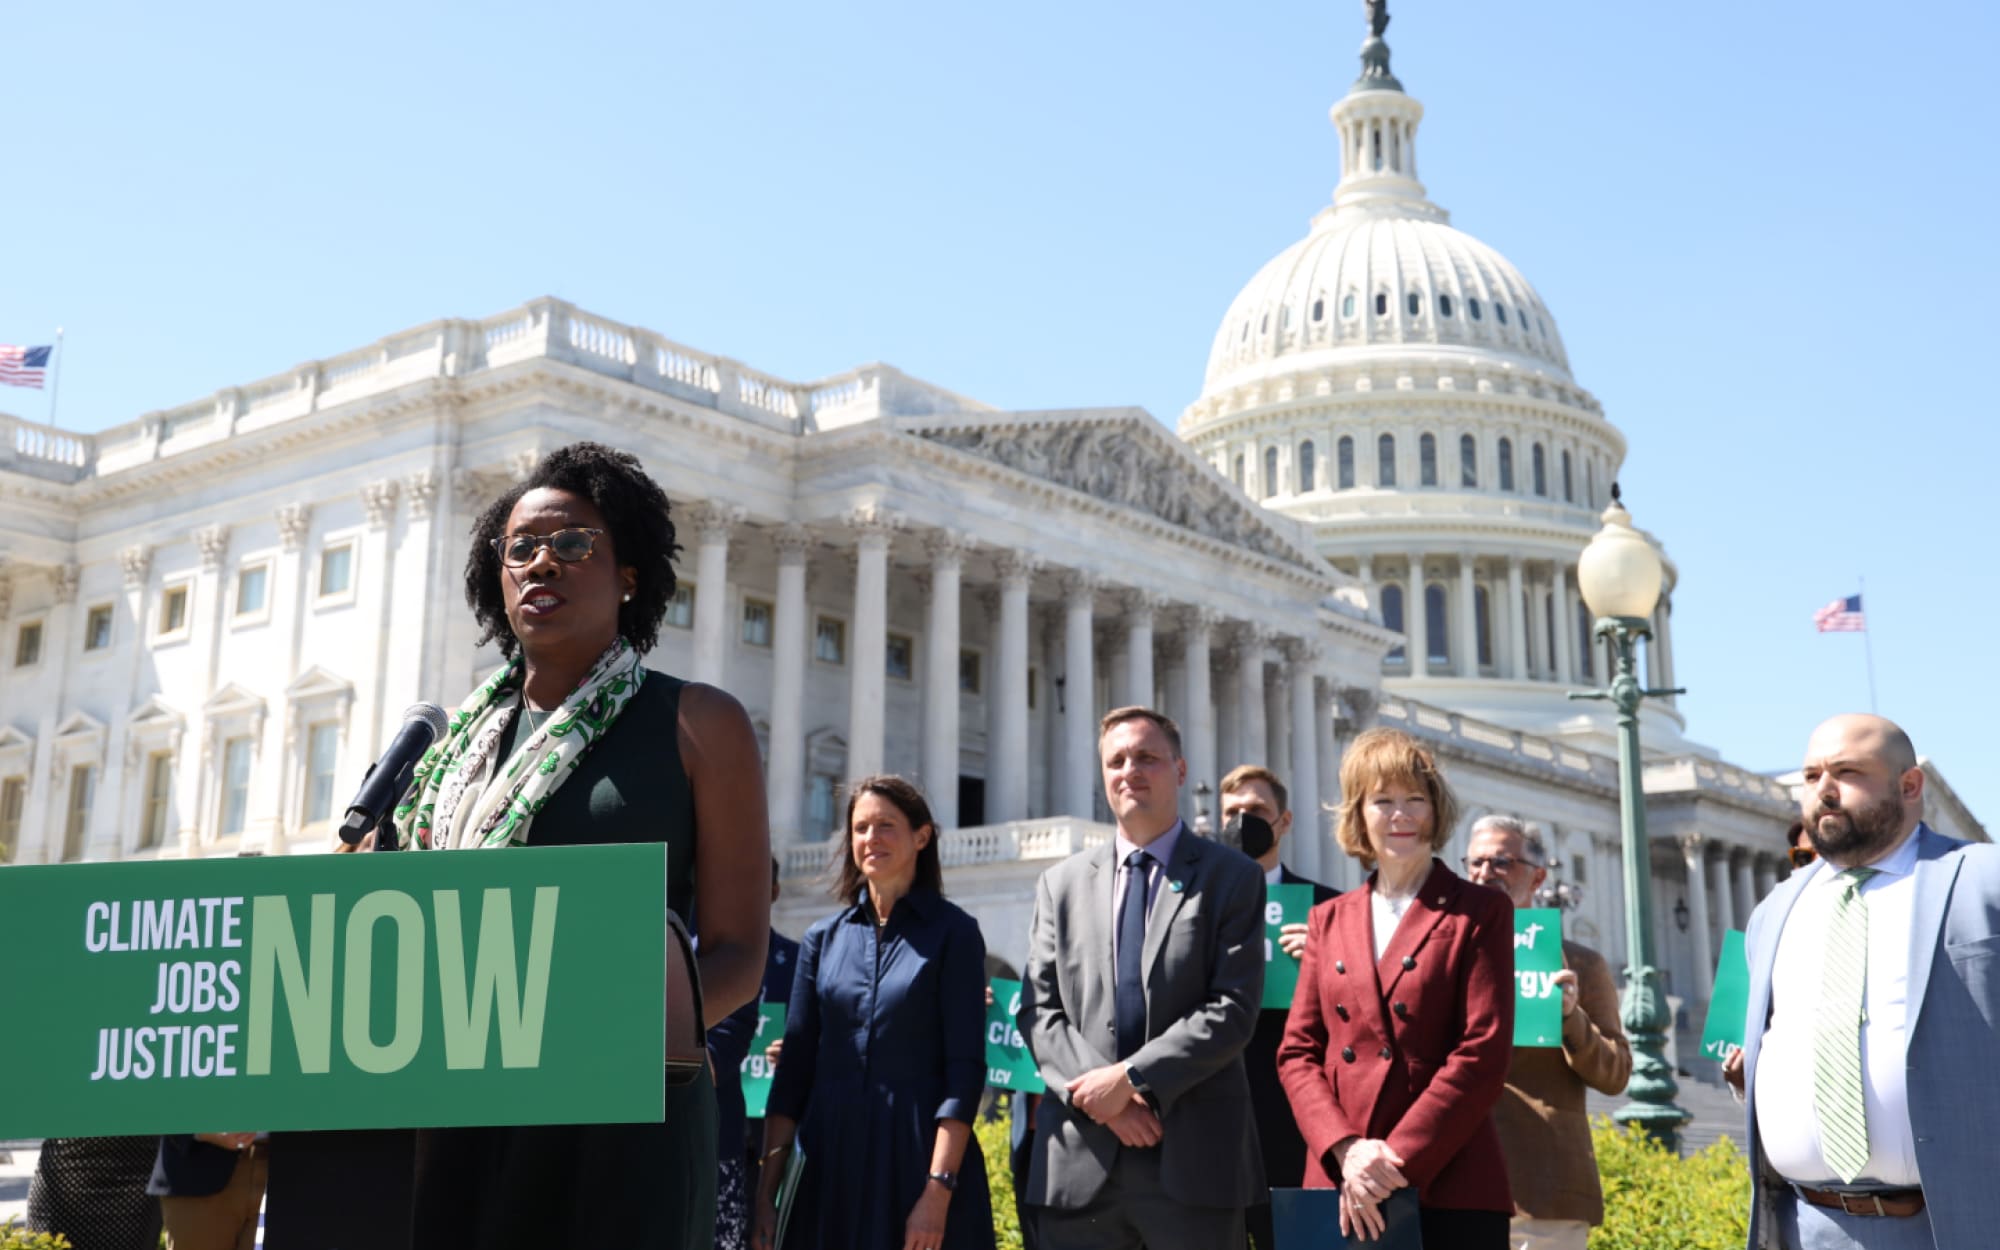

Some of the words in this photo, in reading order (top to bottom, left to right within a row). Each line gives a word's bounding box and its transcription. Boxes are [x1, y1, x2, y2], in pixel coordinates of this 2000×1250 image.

[86, 896, 244, 952] CLIMATE
[150, 960, 241, 1014] JOBS
[246, 886, 560, 1075] NOW
[91, 1024, 239, 1080] JUSTICE
